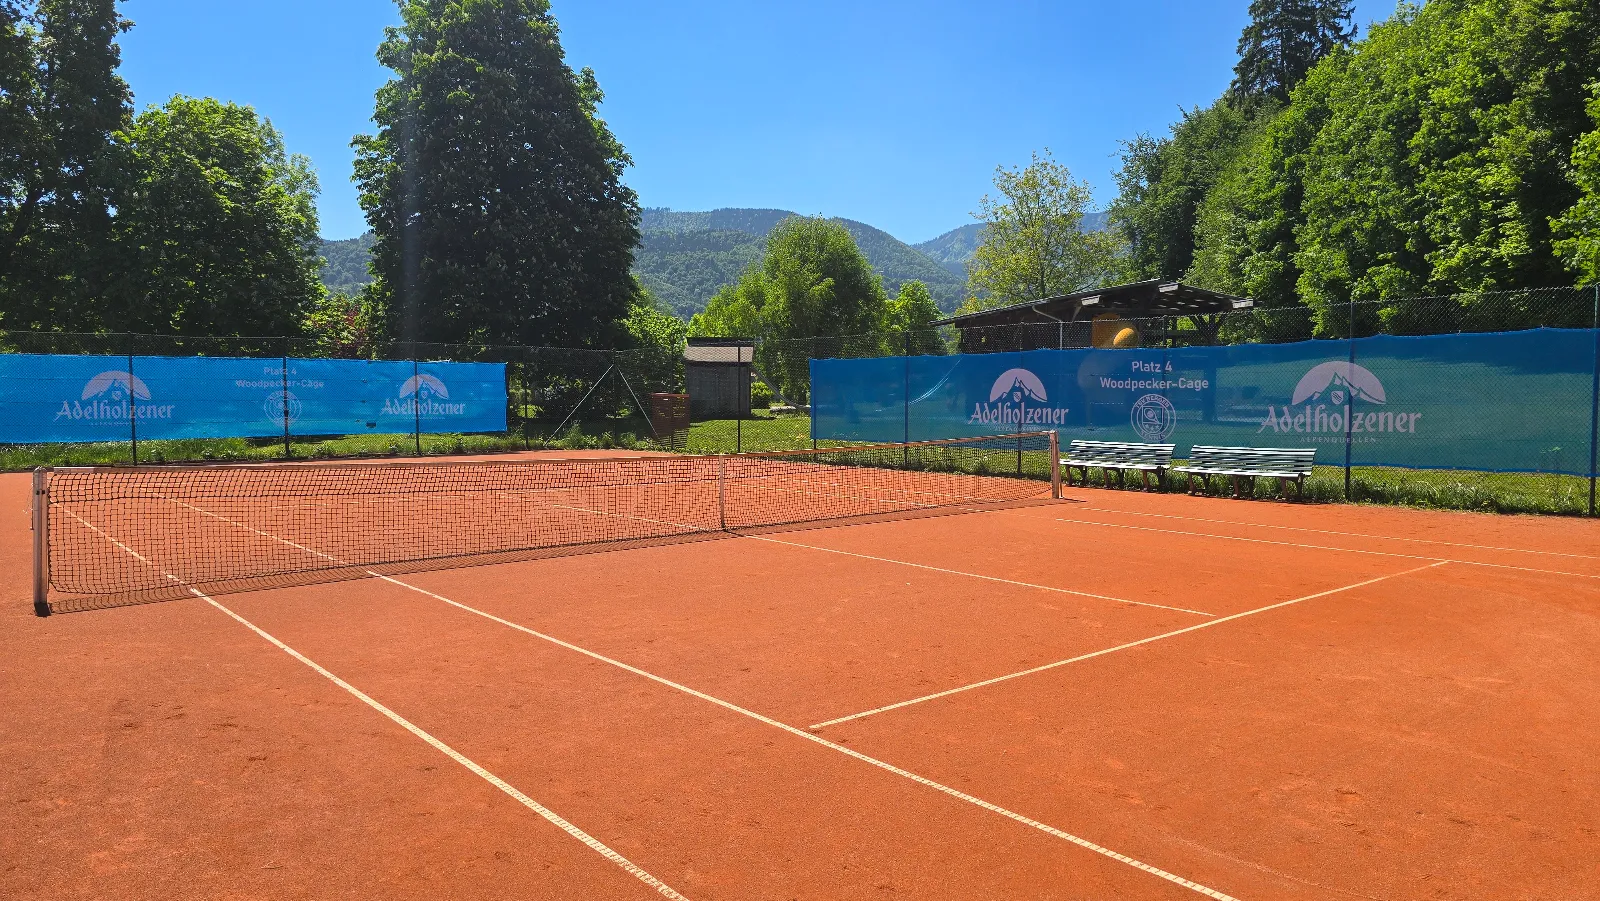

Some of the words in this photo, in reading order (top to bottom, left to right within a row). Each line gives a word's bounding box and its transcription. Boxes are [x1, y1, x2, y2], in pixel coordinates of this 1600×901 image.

[263, 366, 288, 376] Platz
[291, 366, 297, 376] 4
[1131, 360, 1161, 373] Platz
[1165, 360, 1173, 373] 4
[235, 379, 325, 390] Woodpecker-Cage
[1099, 376, 1209, 392] Woodpecker-Cage
[53, 399, 176, 422] Adelholzener
[380, 397, 466, 417] Adelholzener
[967, 401, 1070, 425] Adelholzener
[1256, 403, 1423, 434] Adelholzener
